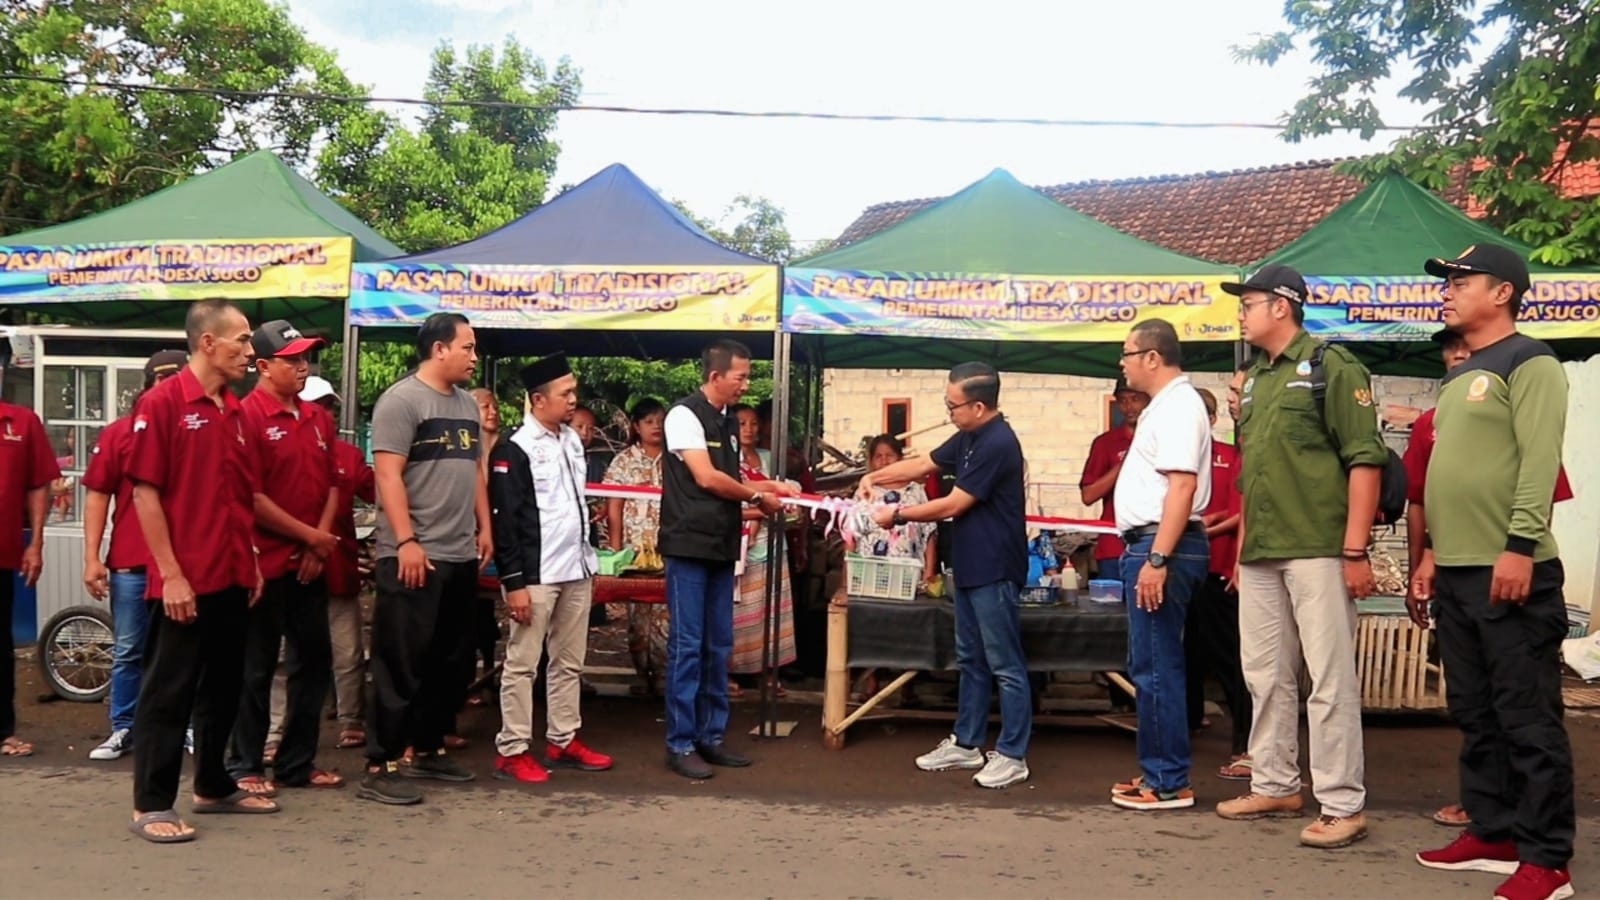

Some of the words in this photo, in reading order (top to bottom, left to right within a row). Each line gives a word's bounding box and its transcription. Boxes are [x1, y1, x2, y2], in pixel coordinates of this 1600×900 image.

[0, 251, 71, 271] PASAR
[75, 248, 150, 269] UMKM
[156, 244, 326, 266] TRADISIONAL
[49, 267, 159, 285] PEMERINTAH
[164, 267, 208, 282] DESA
[211, 267, 260, 282] SUCO
[376, 271, 465, 291] PASAR
[470, 271, 554, 293] UMKM
[564, 272, 749, 295] TRADISIONAL
[812, 275, 908, 299] PASAR
[914, 279, 1004, 300] UMKM
[1014, 281, 1213, 305] TRADISIONAL
[440, 294, 565, 311] PEMERINTAH
[569, 296, 618, 311] DESA
[621, 296, 678, 312] SUCO
[882, 301, 1018, 319] PEMERINTAH
[1023, 305, 1075, 321] DESA
[1078, 305, 1137, 321] SUCO
[1543, 304, 1600, 320] SUCO
